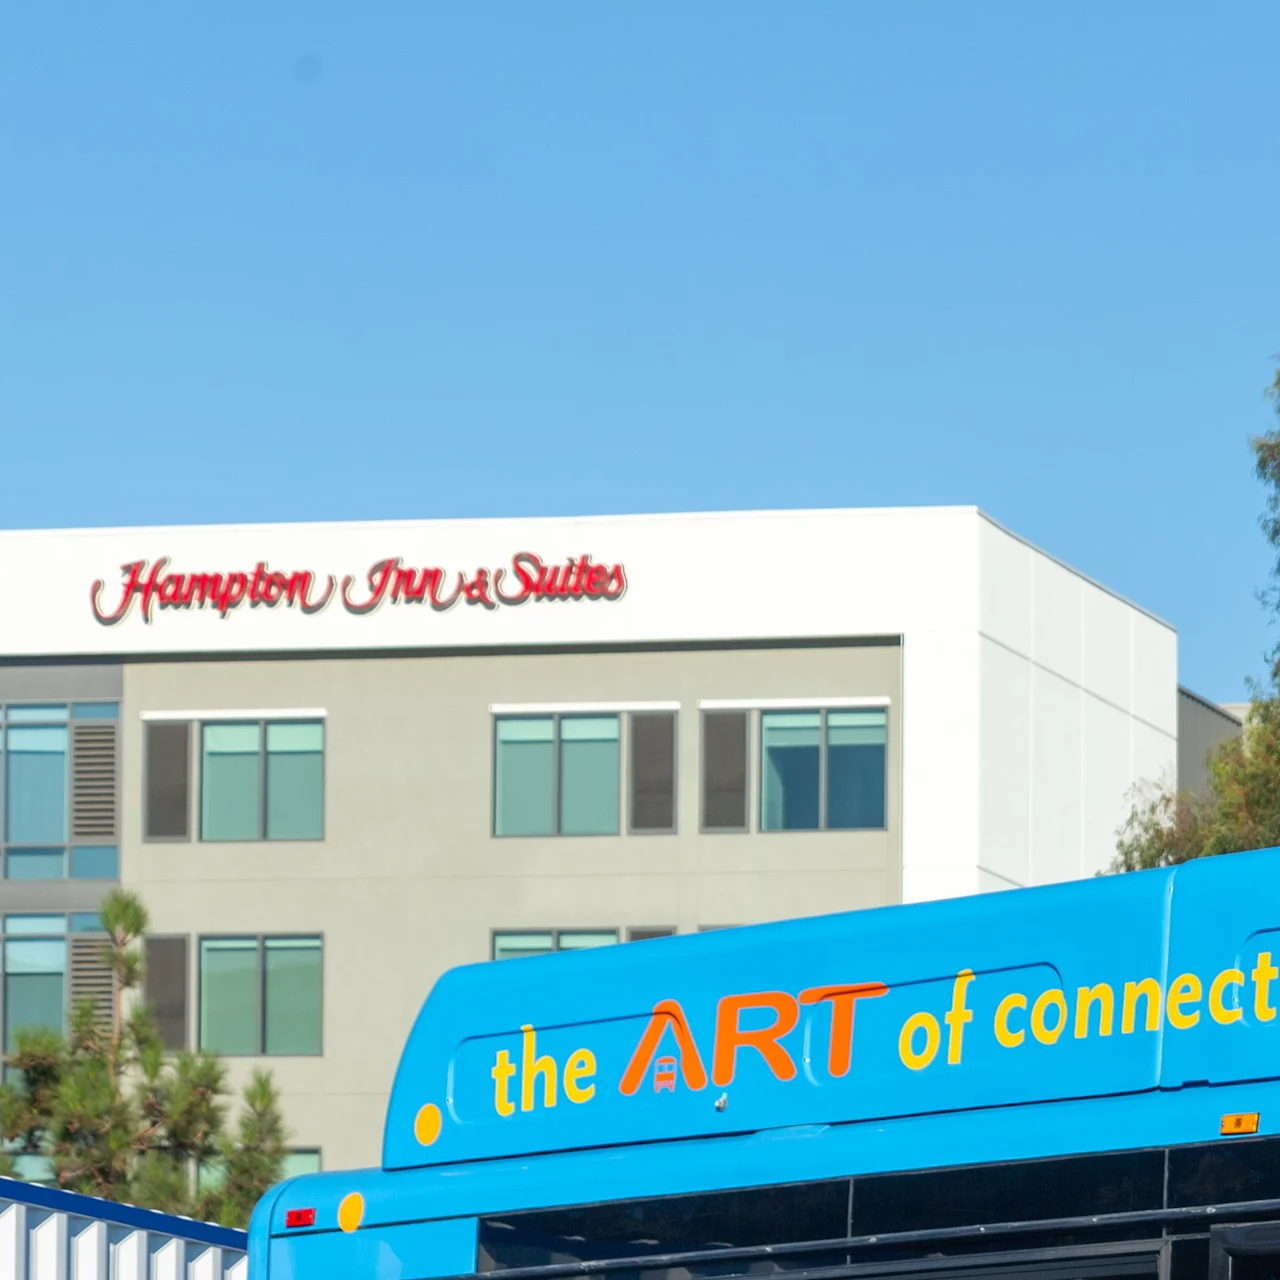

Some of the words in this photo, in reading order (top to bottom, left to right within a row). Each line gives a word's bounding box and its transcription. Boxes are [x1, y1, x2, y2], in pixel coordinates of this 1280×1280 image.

[91, 557, 334, 624] Hampton
[342, 557, 464, 614] Inn
[463, 568, 500, 610] &
[495, 552, 627, 605] Suites
[491, 1025, 596, 1117] the
[618, 982, 890, 1096] ART
[898, 969, 976, 1071] of
